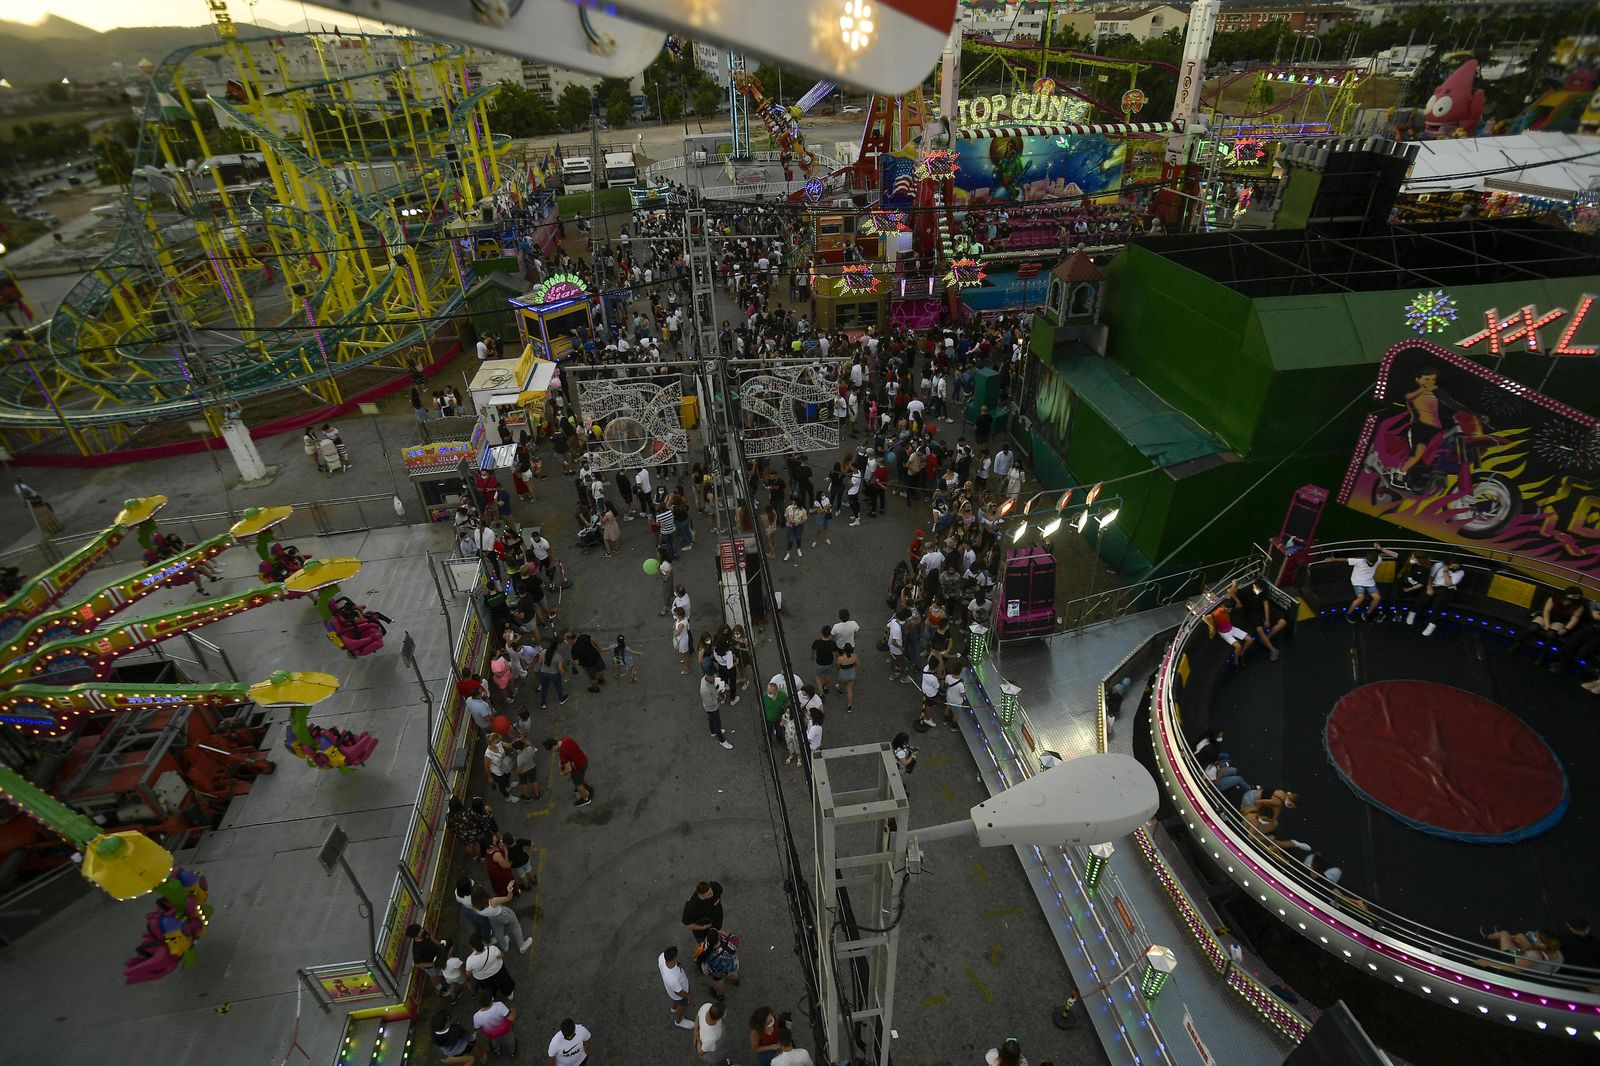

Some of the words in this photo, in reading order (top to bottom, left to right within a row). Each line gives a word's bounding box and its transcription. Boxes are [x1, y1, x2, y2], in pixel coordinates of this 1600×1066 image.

[1180, 61, 1196, 104] TOP
[958, 95, 1007, 126] TOP
[1012, 93, 1068, 121] GUN
[1453, 293, 1599, 356] XXL
